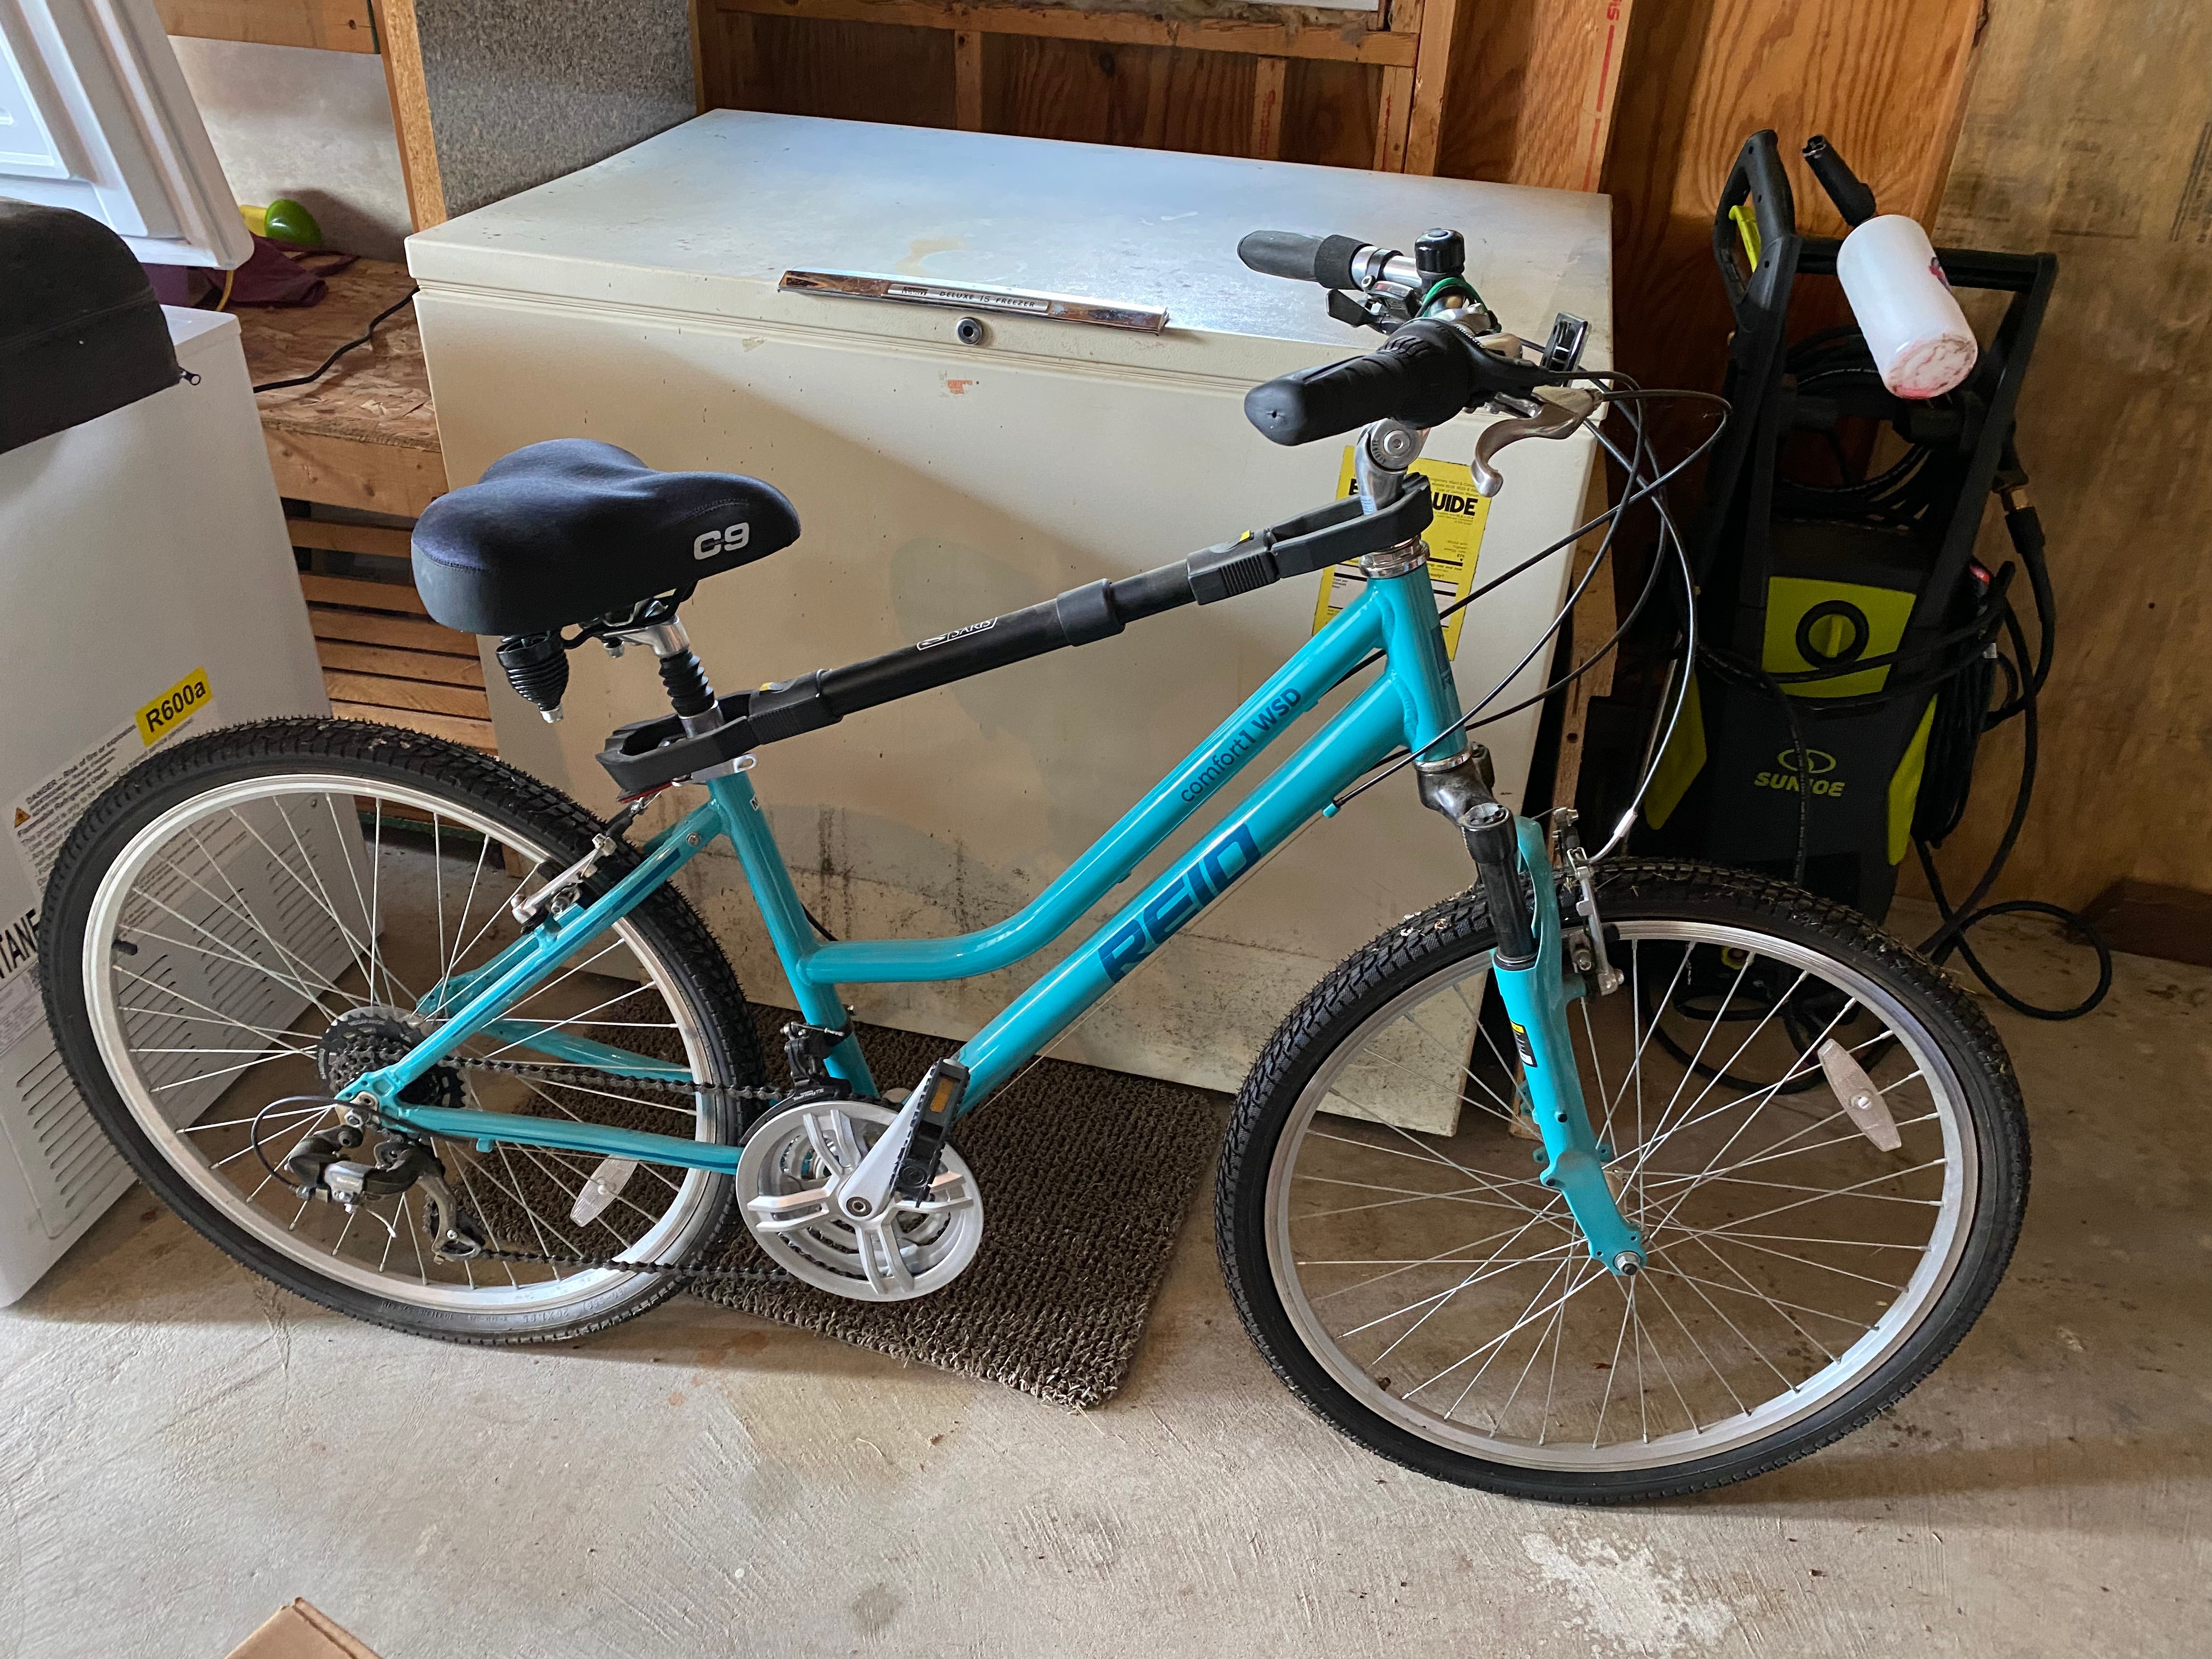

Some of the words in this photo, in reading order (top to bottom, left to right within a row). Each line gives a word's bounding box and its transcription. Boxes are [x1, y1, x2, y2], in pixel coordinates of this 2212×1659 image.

[940, 291, 974, 300] DELUXE
[996, 297, 1035, 308] FREEZER
[1432, 492, 1479, 516] UIDE
[693, 522, 749, 560] C9
[145, 679, 206, 733] R600a
[1251, 688, 1301, 731] WSD
[1754, 772, 1845, 797] SUNOE
